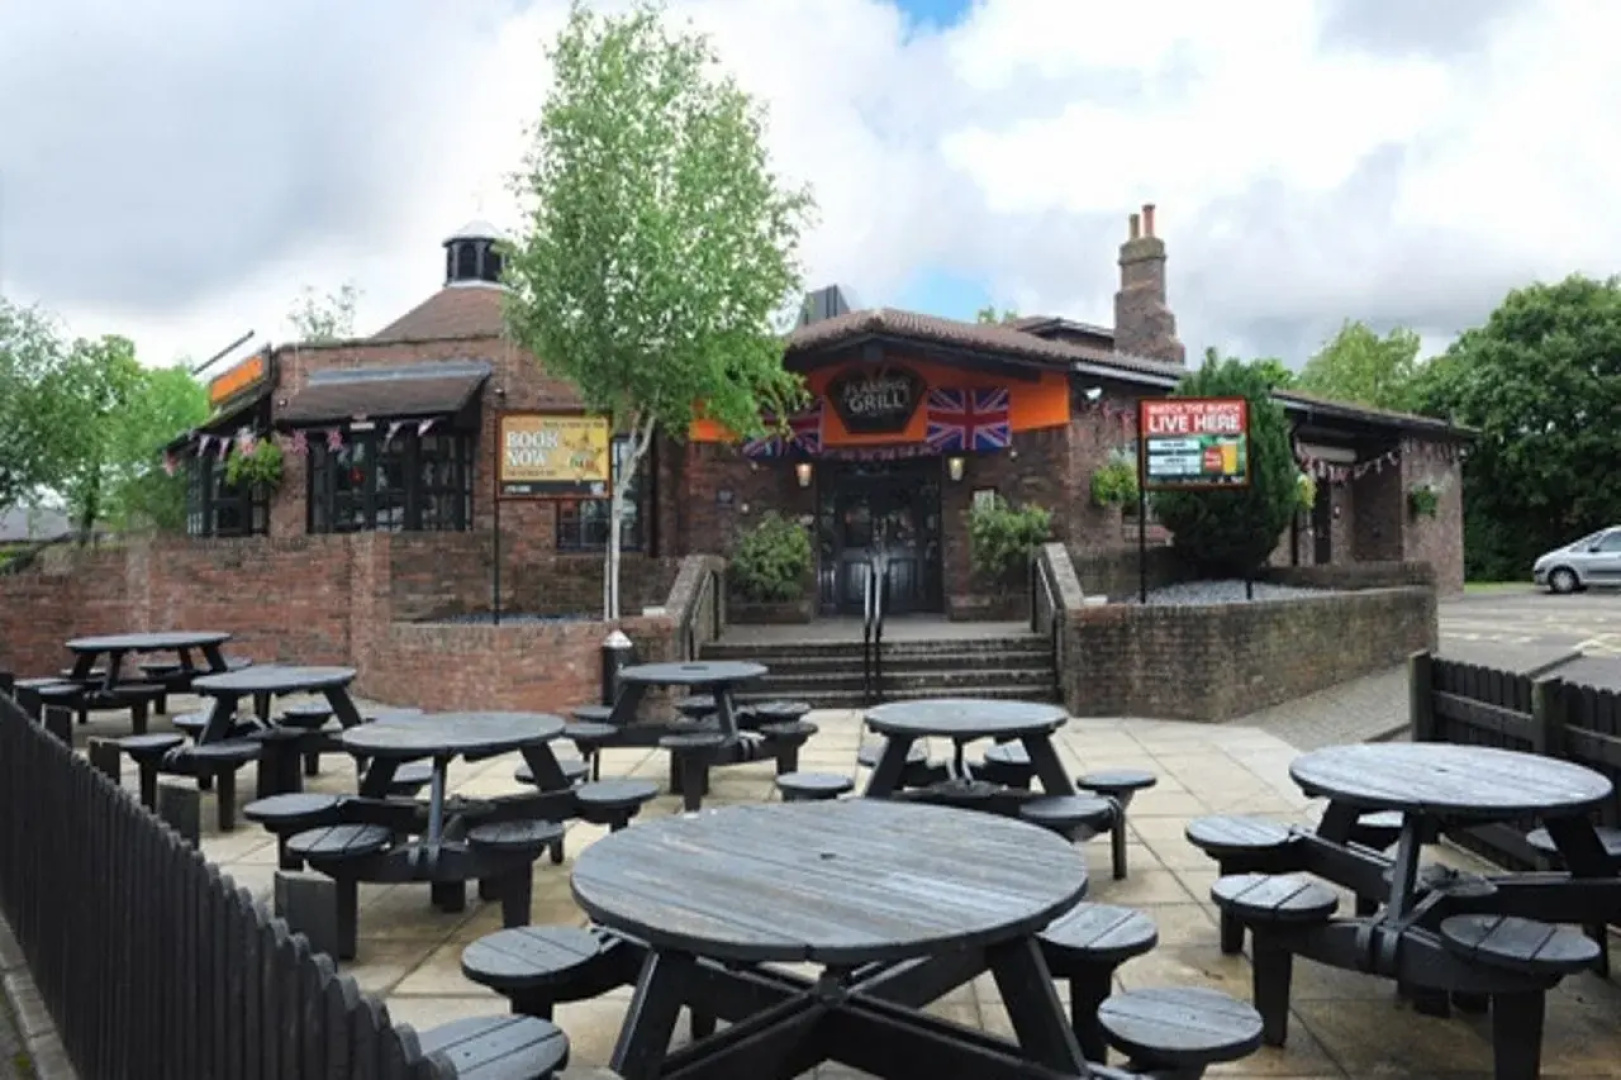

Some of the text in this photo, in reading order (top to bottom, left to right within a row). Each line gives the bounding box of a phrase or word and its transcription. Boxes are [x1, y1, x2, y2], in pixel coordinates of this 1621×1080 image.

[849, 391, 904, 413] GRILL
[1149, 413, 1241, 433] LIVE HERE
[506, 431, 559, 449] BOOK
[506, 448, 549, 467] NOW
